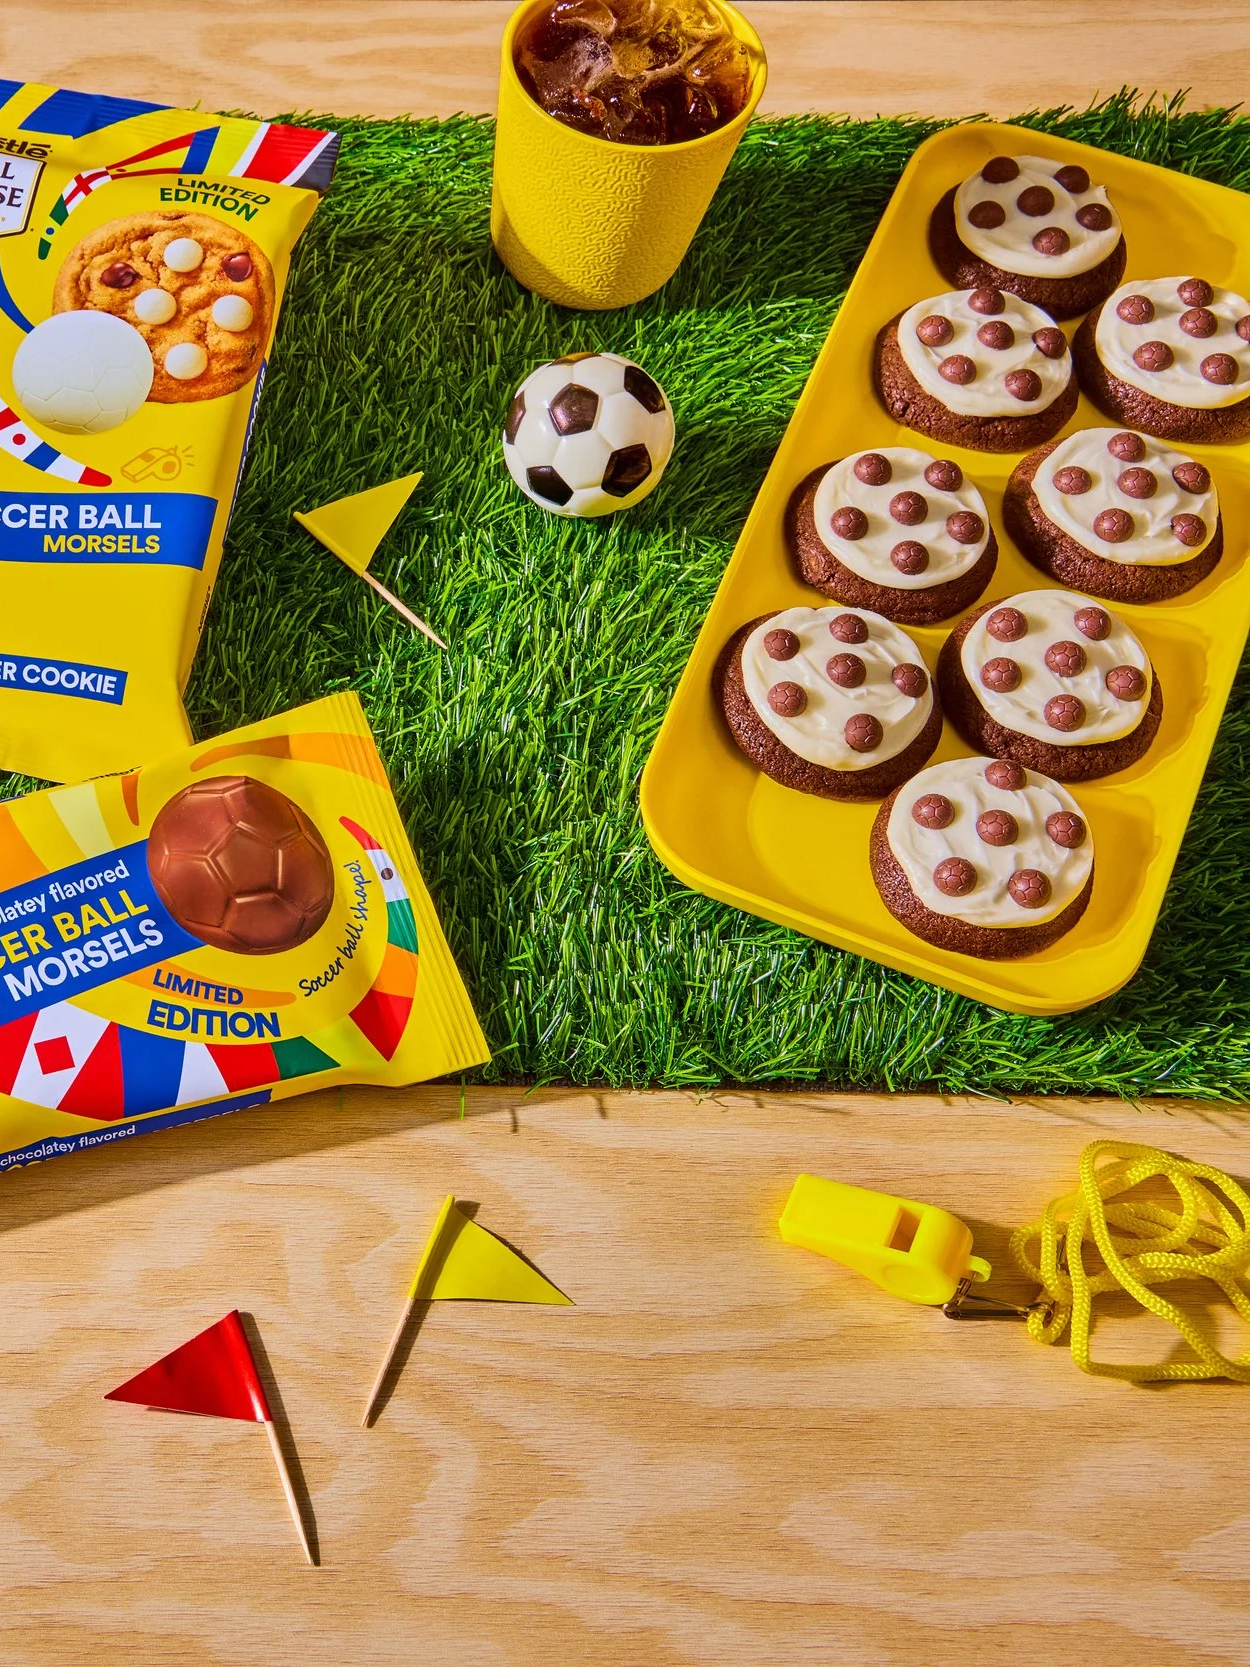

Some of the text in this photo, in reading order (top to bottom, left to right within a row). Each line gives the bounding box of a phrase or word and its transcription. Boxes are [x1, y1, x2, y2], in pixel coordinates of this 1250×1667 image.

[160, 187, 259, 222] EDITION
[177, 178, 271, 205] LIMITED
[78, 504, 162, 529] BALL
[43, 534, 161, 554] MORSELS
[22, 663, 117, 696] COOKIE
[49, 859, 130, 903] flavored
[52, 889, 149, 943] BALL
[298, 860, 372, 997] Soccer ball shape!
[3, 918, 163, 1002] MORSELS
[152, 968, 244, 1005] LIMITED
[147, 999, 282, 1038] EDITION
[0, 1140, 76, 1167] chocolatey
[78, 1124, 136, 1148] flavored
